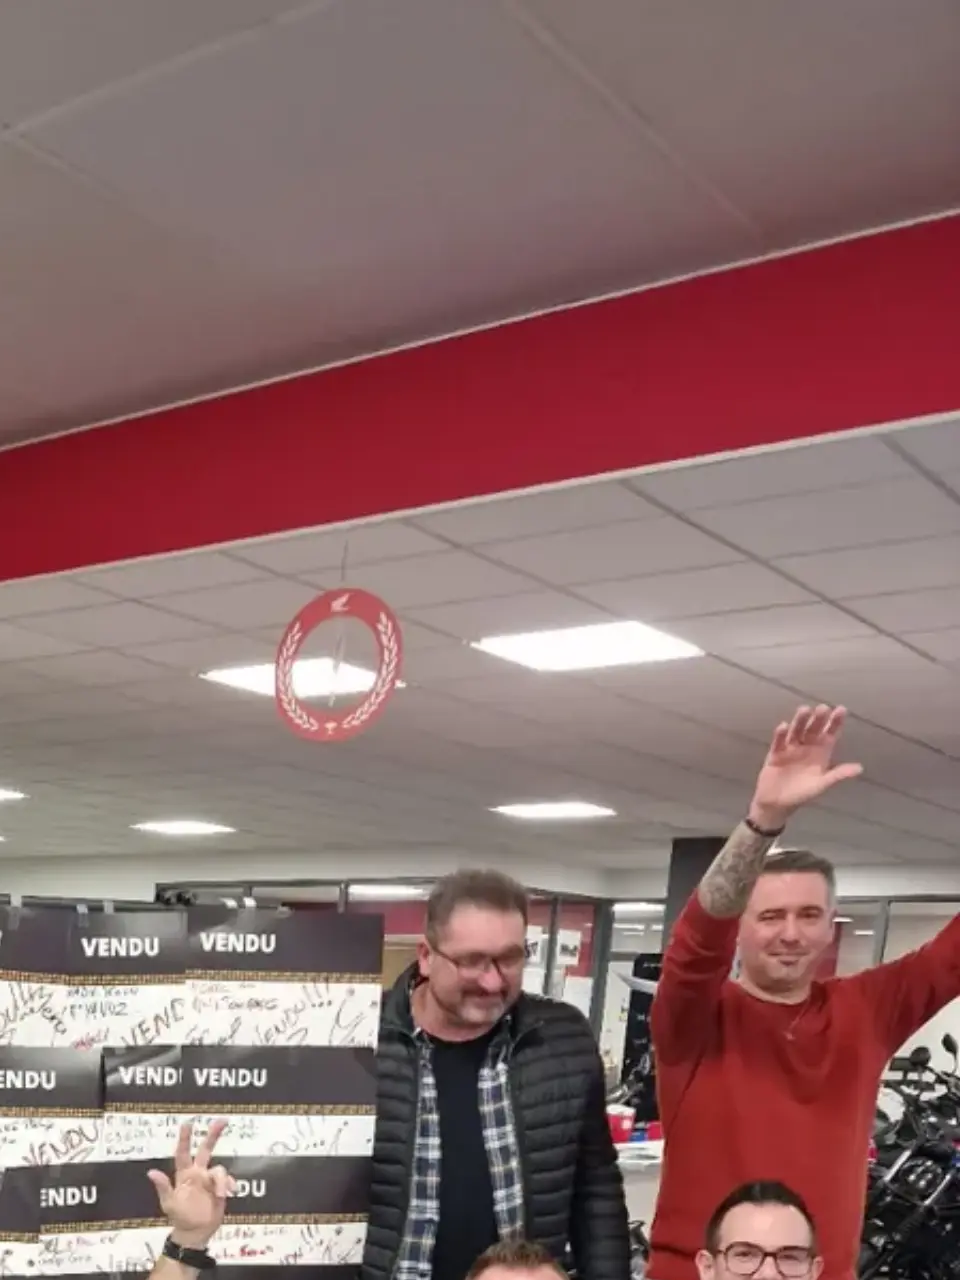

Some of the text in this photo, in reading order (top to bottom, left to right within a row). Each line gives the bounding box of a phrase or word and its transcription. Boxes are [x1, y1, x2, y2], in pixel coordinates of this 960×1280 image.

[81, 936, 161, 957] VENDU
[199, 931, 277, 953] VENDU
[119, 1066, 182, 1086] VEND
[193, 1067, 268, 1087] VENDU
[40, 1185, 97, 1208] ENDU
